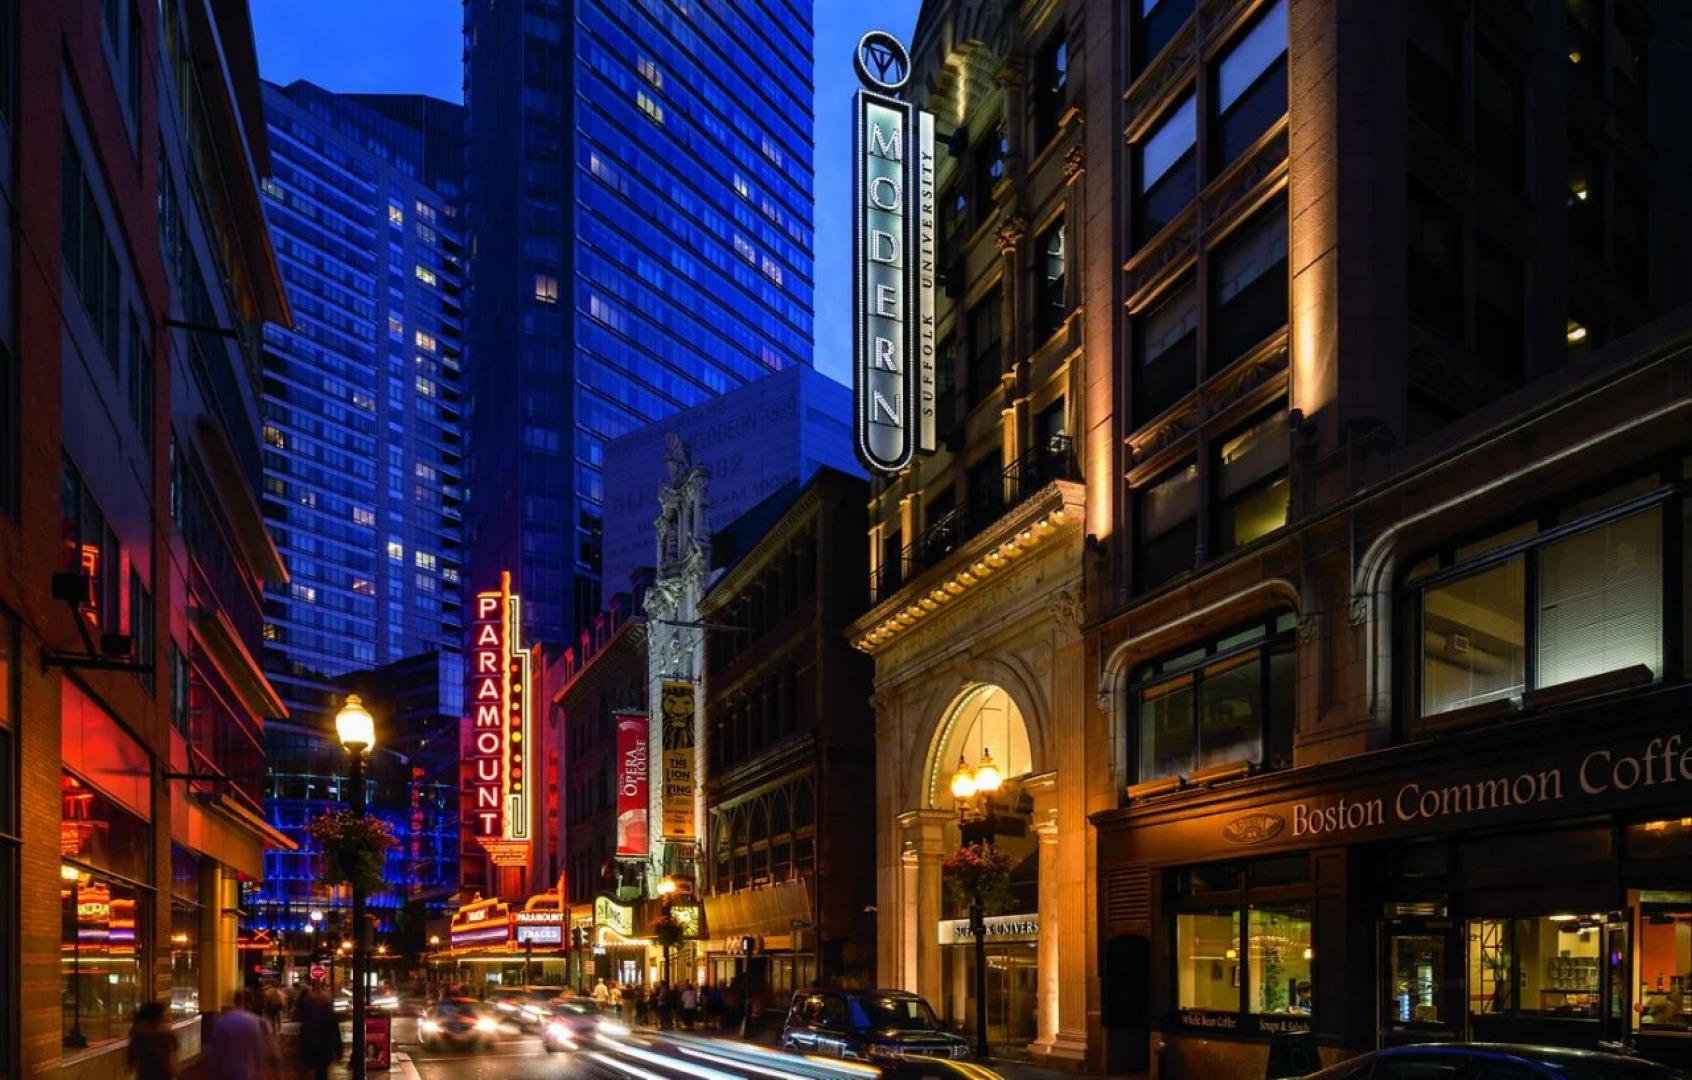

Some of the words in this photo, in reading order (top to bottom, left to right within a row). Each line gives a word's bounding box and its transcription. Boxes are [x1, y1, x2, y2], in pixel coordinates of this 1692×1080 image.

[923, 152, 933, 288] UNIVERSITY
[870, 122, 901, 427] MODERN
[923, 315, 933, 416] SUFFOLK
[477, 598, 500, 834] PARAMOUNT
[623, 749, 637, 797] OPERA
[636, 740, 646, 781] HOUSE
[666, 767, 691, 782] LION
[670, 758, 687, 769] THE
[667, 784, 692, 797] KING
[1292, 799, 1384, 836] Boston
[1395, 768, 1564, 821] Common
[1579, 734, 1692, 794] Coffe
[517, 912, 564, 921] PARAMOUNT
[1182, 1014, 1201, 1026] Whole
